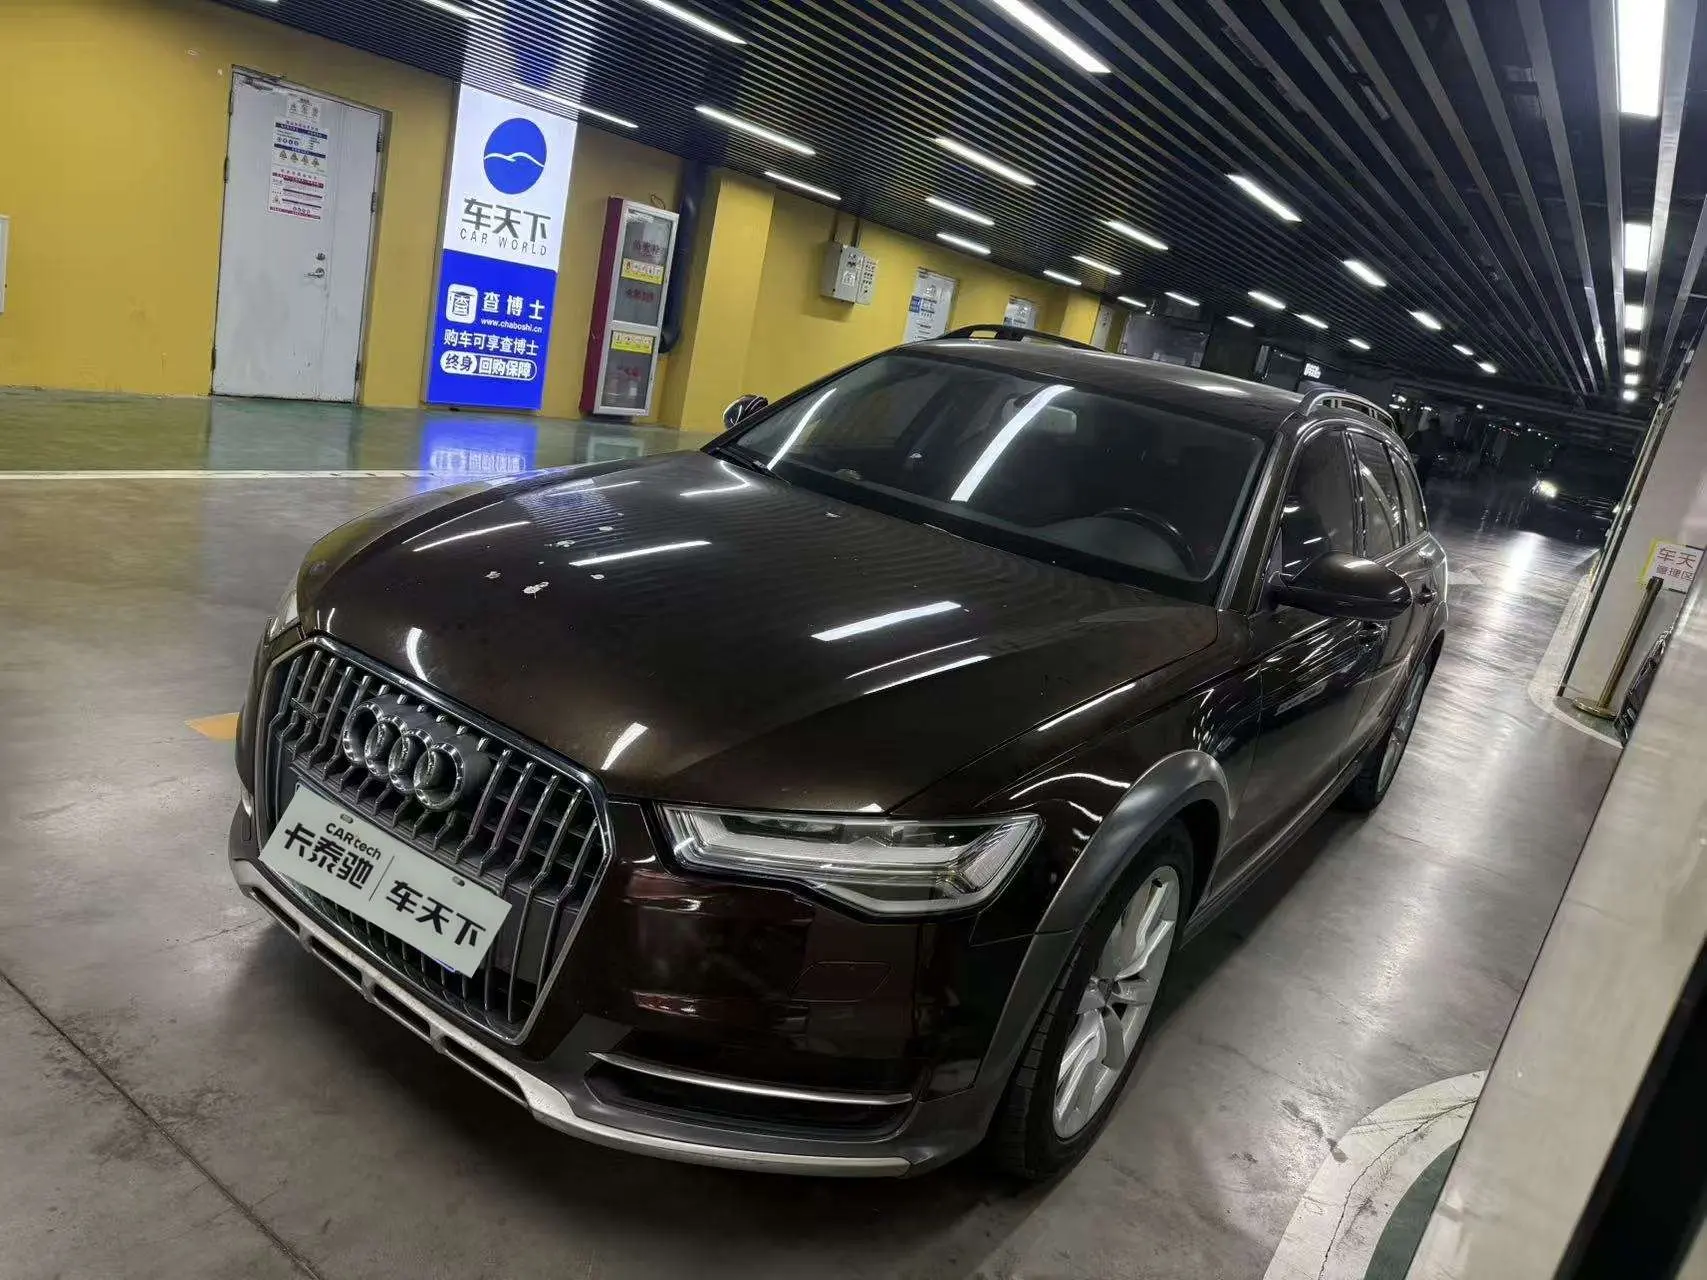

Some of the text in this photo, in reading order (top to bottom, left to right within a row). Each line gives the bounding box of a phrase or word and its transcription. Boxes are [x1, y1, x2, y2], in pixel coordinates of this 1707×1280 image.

[462, 198, 551, 242] 车天下
[460, 228, 547, 256] CAR WORLD
[482, 291, 545, 320] 查博士
[481, 318, 543, 333] www.chaboshi.cn
[443, 328, 539, 356] 购车可享查博士
[445, 353, 532, 379] 终身 回购保障
[325, 822, 382, 861] CARtech
[283, 822, 487, 947] 卡泰驰 车天下
